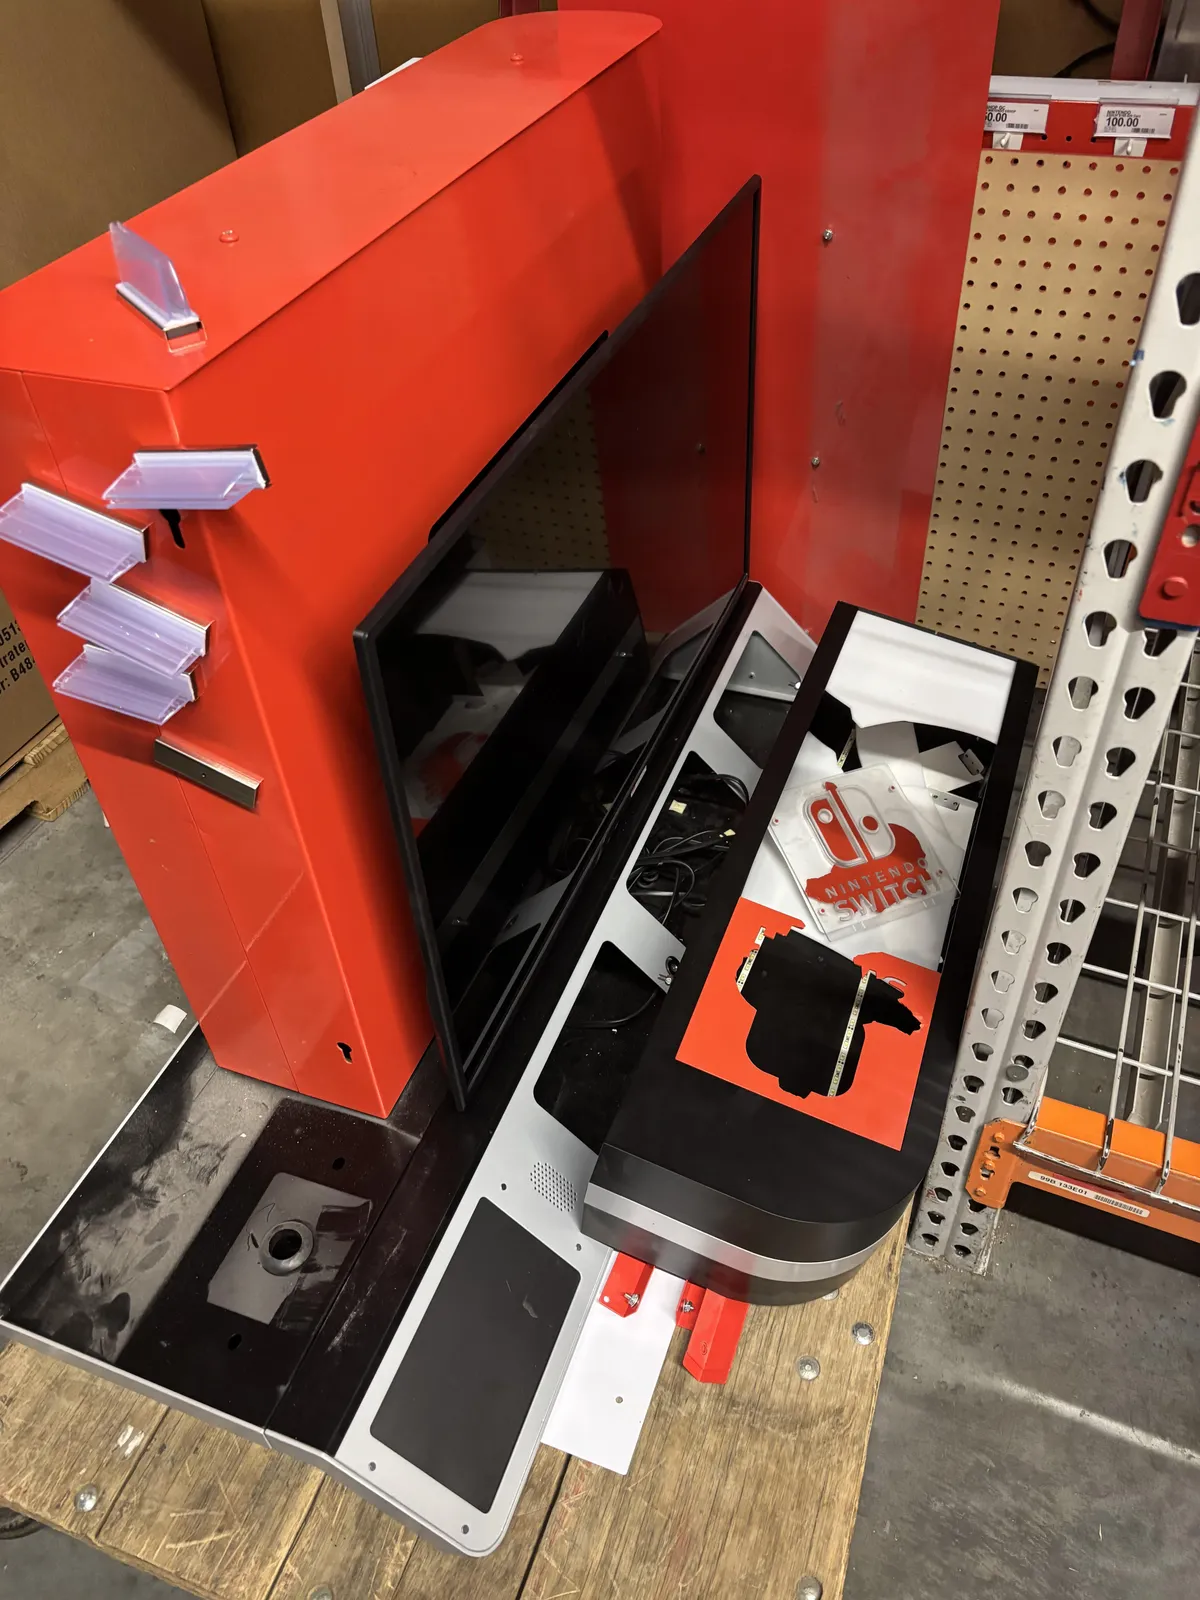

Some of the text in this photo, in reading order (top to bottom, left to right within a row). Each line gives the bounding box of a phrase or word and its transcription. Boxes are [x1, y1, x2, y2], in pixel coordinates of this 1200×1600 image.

[1106, 117, 1139, 127] 100.00
[0, 640, 30, 668] trate
[10, 657, 35, 681] B48
[825, 858, 928, 899] NINTENDO
[833, 872, 941, 921] SWITCH
